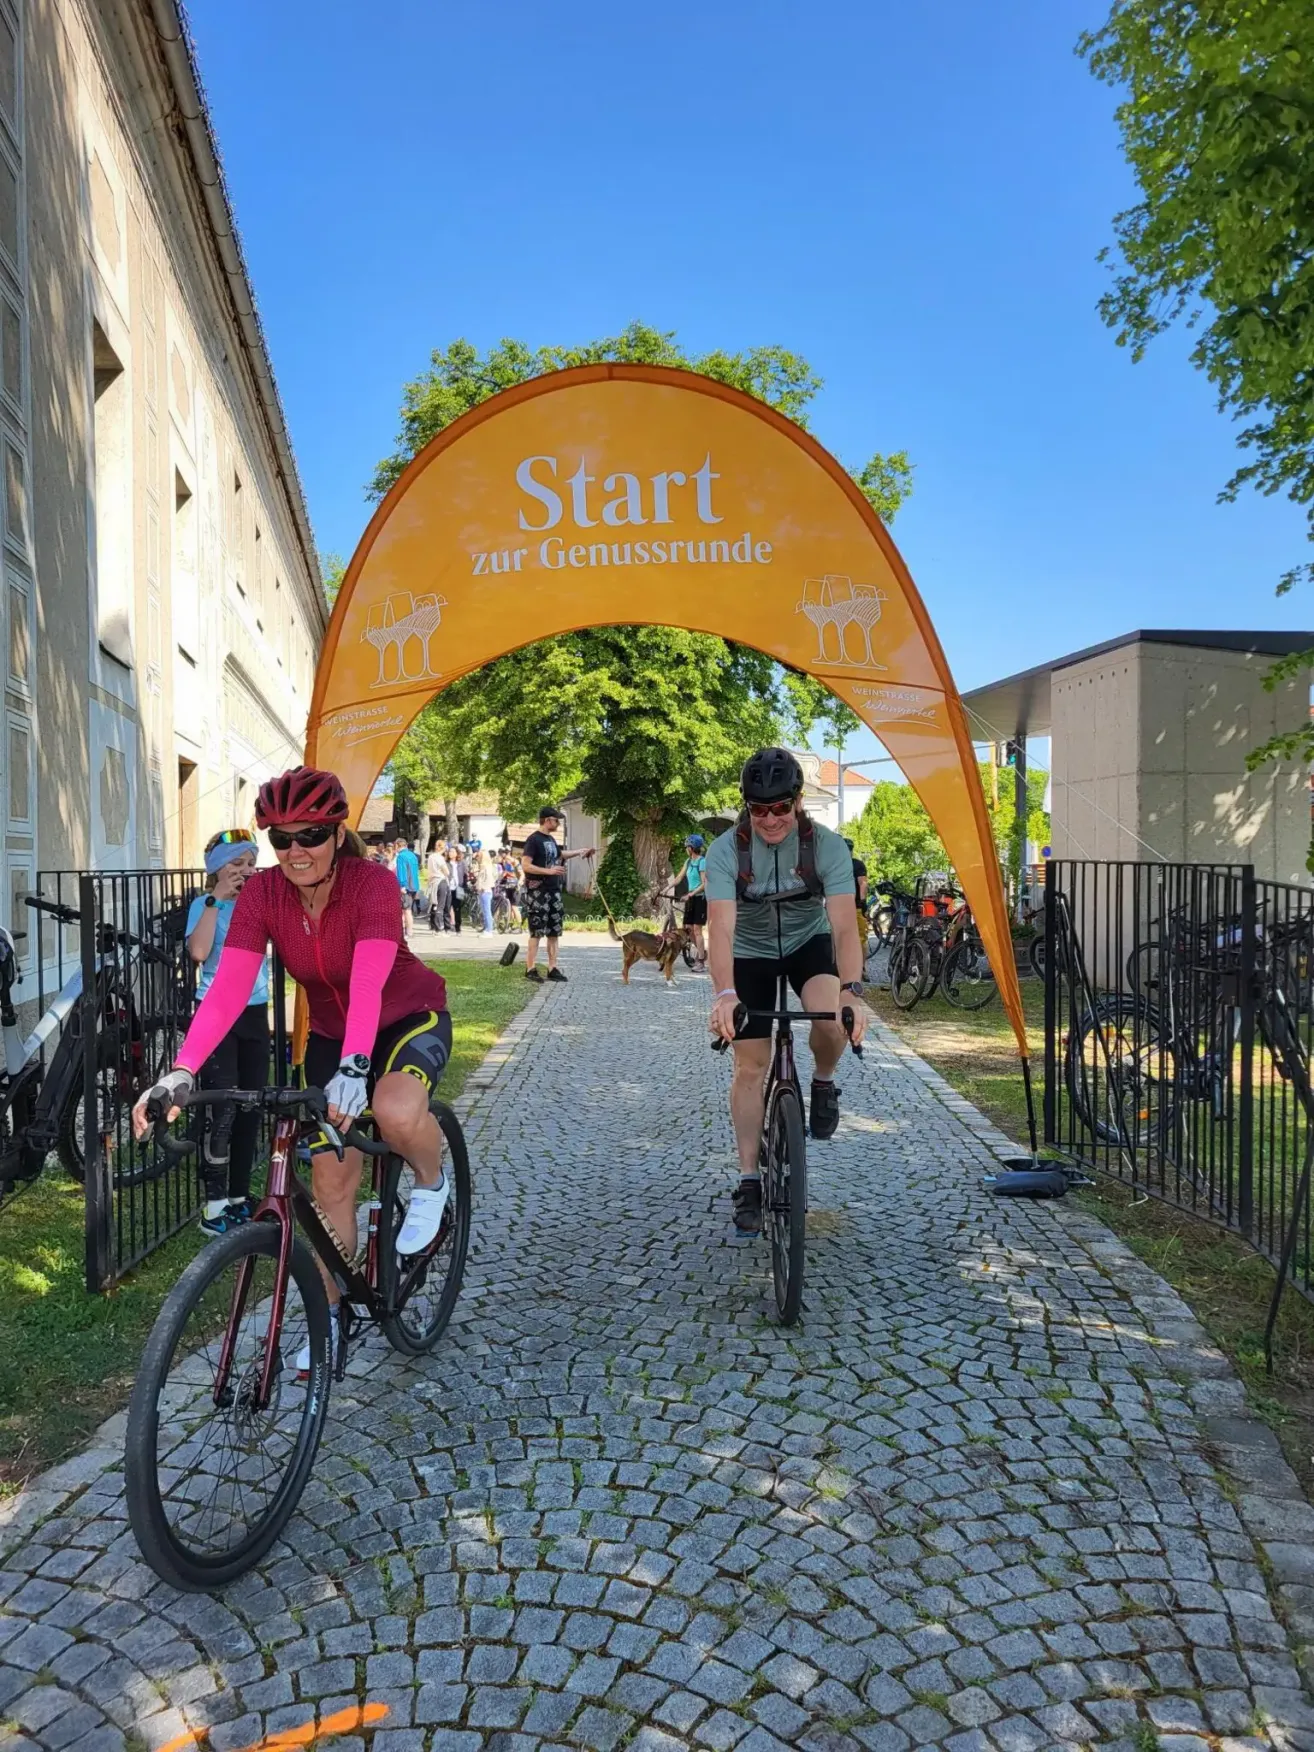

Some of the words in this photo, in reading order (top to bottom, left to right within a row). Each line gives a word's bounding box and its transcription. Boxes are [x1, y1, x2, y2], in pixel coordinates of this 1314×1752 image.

[516, 452, 725, 531] Start
[471, 549, 529, 577] zur
[539, 532, 773, 571] Genussrunde
[323, 705, 388, 727] WEINSTRASSE
[851, 686, 922, 702] WEINSTRASSE
[310, 1200, 361, 1276] MERIDA
